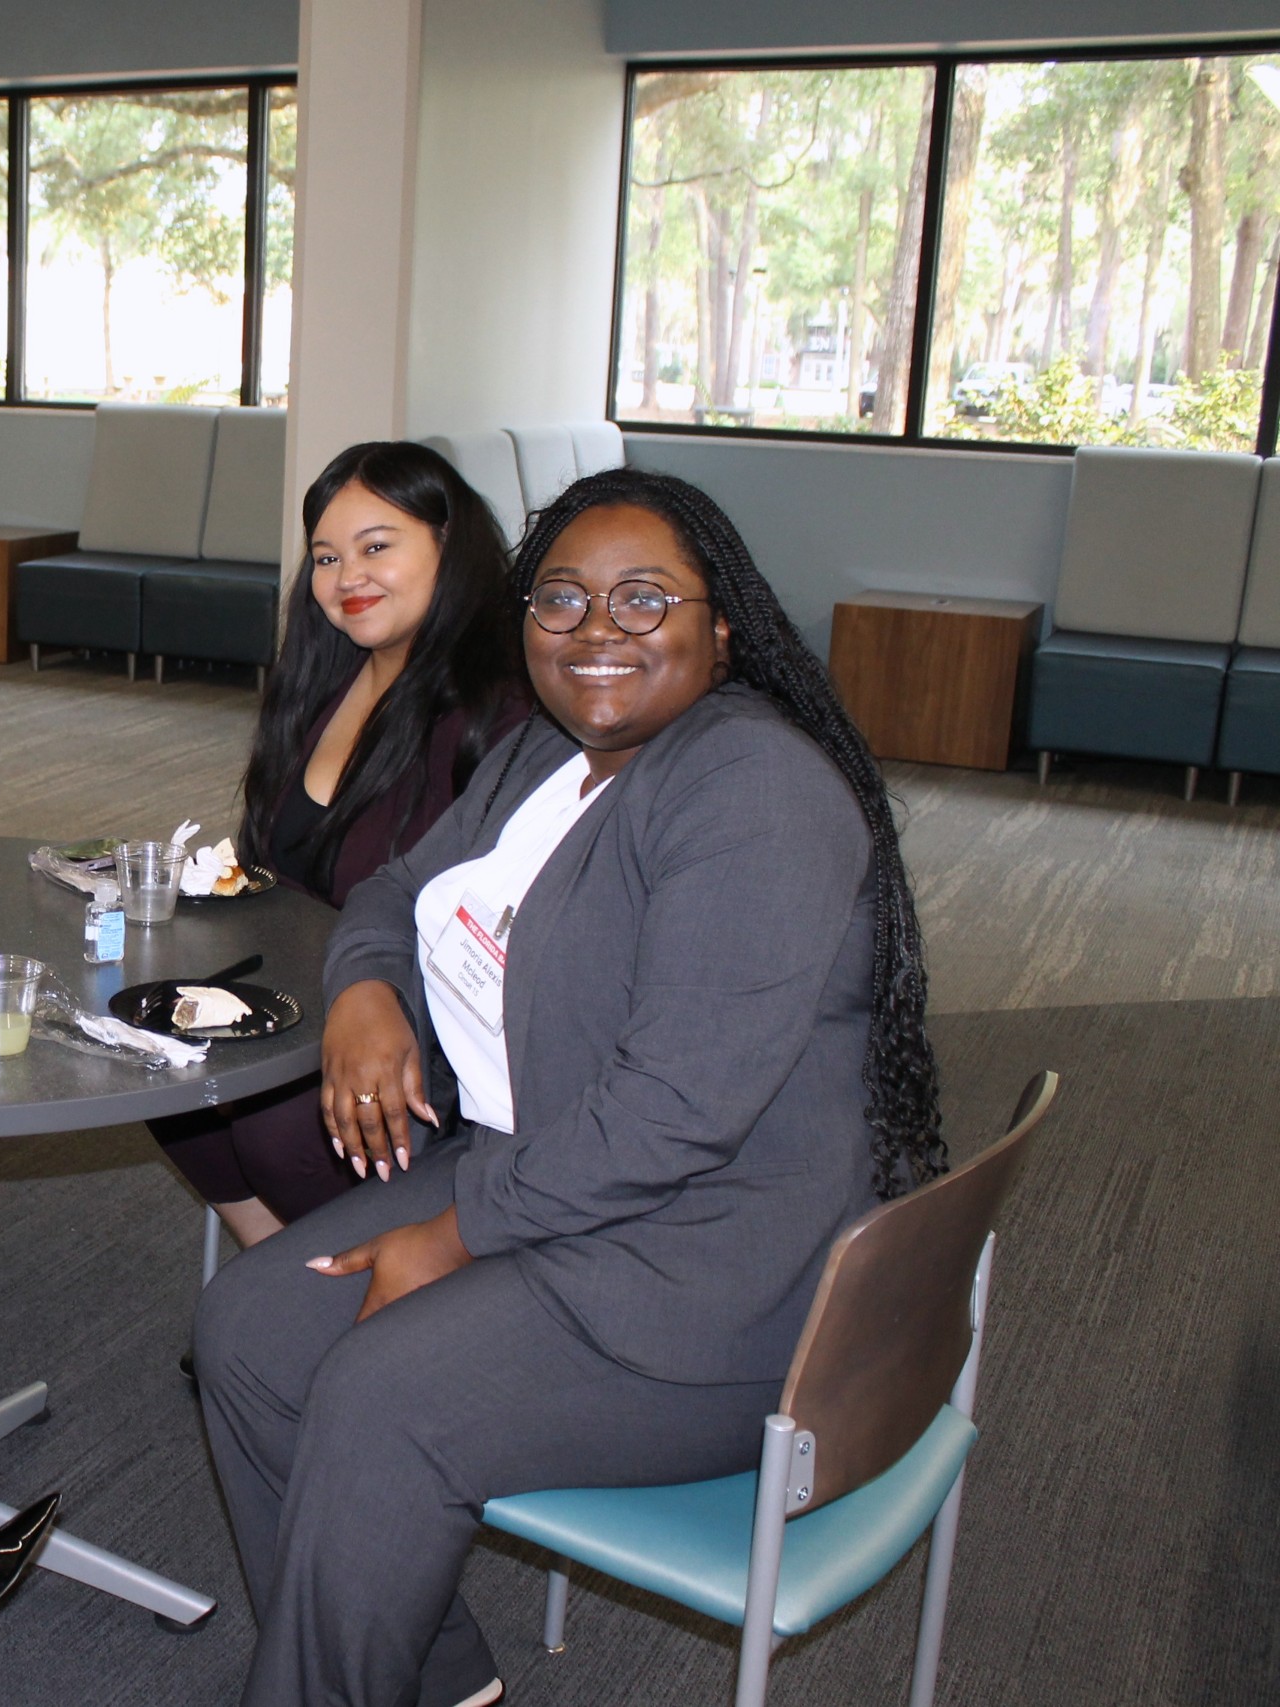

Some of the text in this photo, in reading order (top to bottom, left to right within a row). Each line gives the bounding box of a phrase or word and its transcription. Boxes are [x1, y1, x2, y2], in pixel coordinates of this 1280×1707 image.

[466, 918, 479, 934] THE
[476, 931, 499, 958] FLORIDA
[459, 939, 503, 987] Jimoria Alexis
